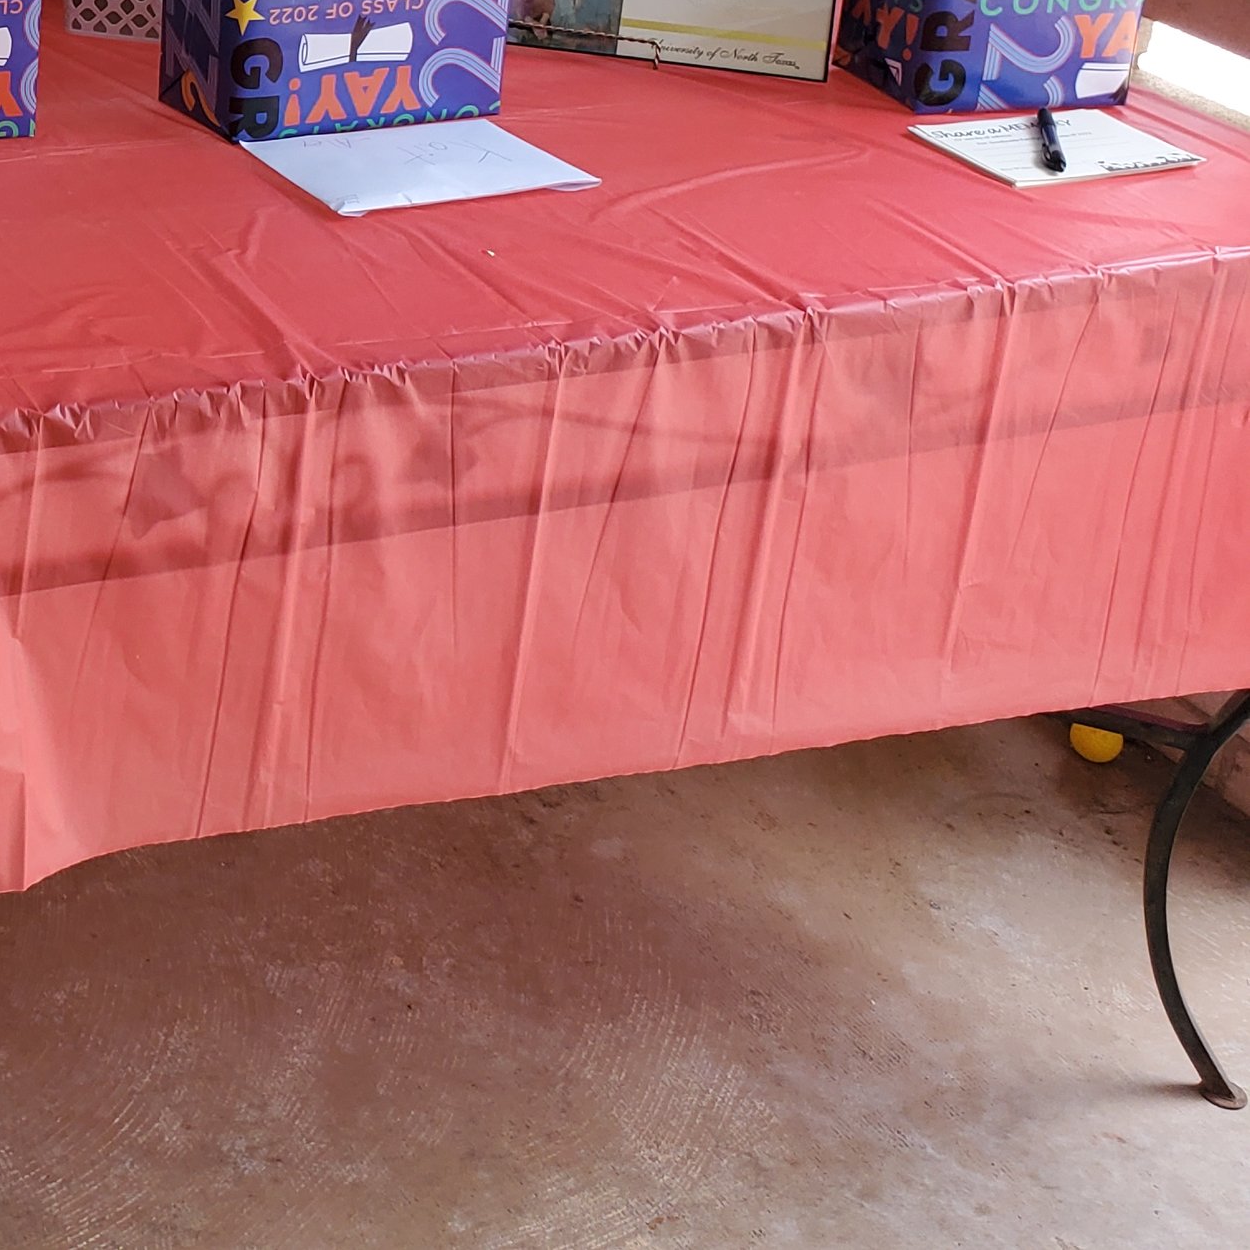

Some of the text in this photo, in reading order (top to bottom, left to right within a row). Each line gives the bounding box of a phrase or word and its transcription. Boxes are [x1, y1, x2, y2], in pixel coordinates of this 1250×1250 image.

[269, 6, 318, 26] 2022
[326, 2, 353, 21] OF
[720, 48, 758, 62] North
[283, 66, 421, 126] YAY!
[931, 128, 986, 140] Share
